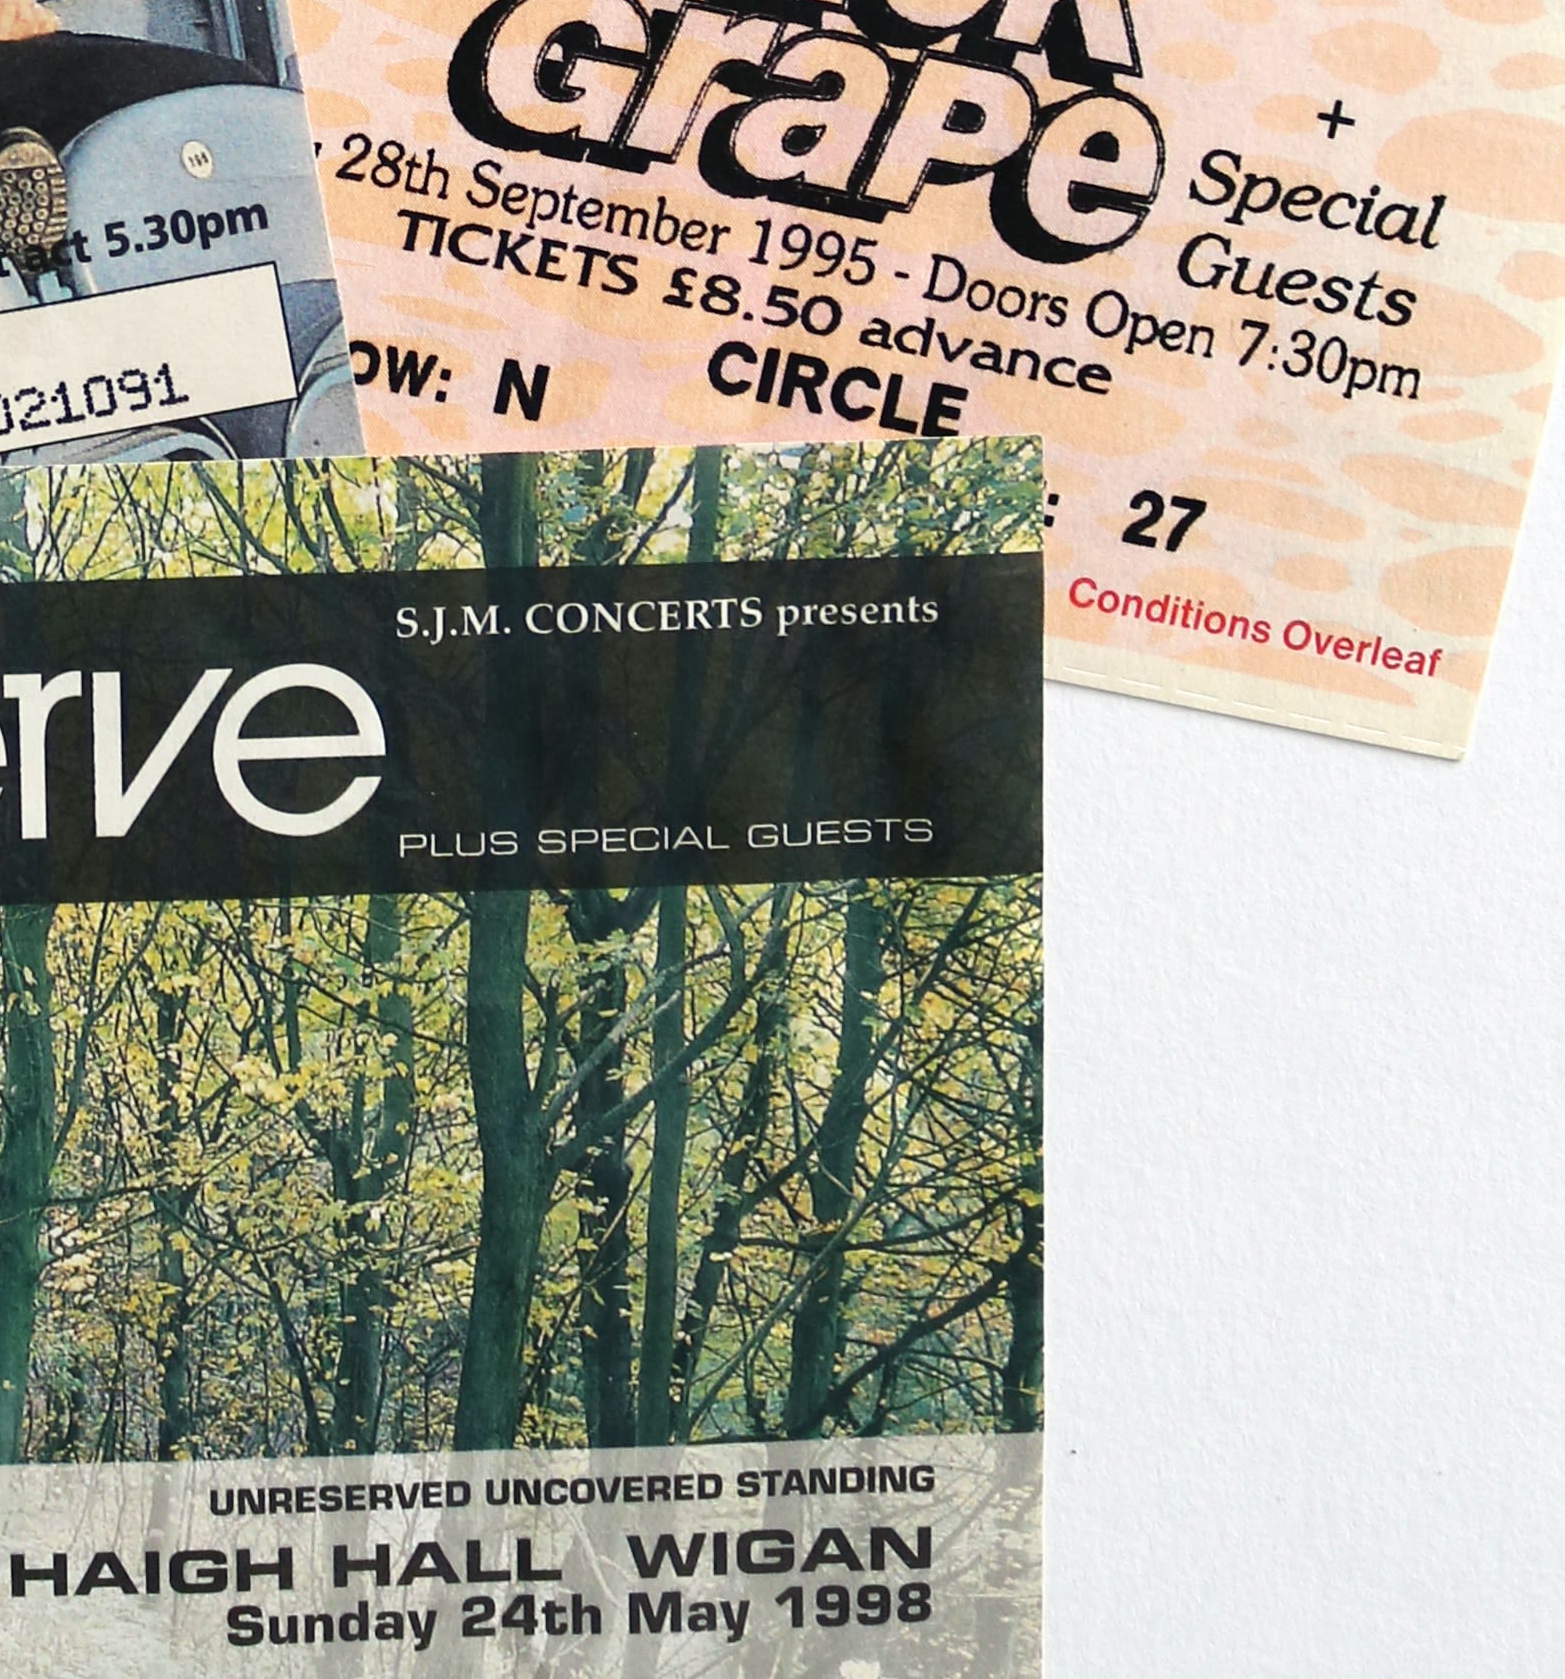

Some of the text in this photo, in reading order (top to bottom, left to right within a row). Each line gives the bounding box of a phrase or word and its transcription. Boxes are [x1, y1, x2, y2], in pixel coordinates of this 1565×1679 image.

[104, 203, 270, 262] 5.30pm
[1189, 149, 1446, 248] Special
[334, 134, 1422, 399] 28th September 1995 Doors Open 7:30pm
[1178, 233, 1417, 325] Guests
[397, 209, 1113, 395] TICKETS £8.50 advance
[494, 359, 549, 421] N
[707, 342, 969, 437] CIRCLE
[1122, 490, 1207, 552] 27
[395, 596, 939, 645] S.J.M. CONCERTS presents
[1068, 578, 1442, 677] Conditions Overleaf
[399, 819, 934, 858] PLUS SPECIAL GUESTS
[210, 1465, 936, 1517] UNRESERVED UNCOVERED STANDING
[9, 1527, 933, 1598] HAIGH HALL WIGAN
[226, 1582, 932, 1650] Sunday 24th May 1998
